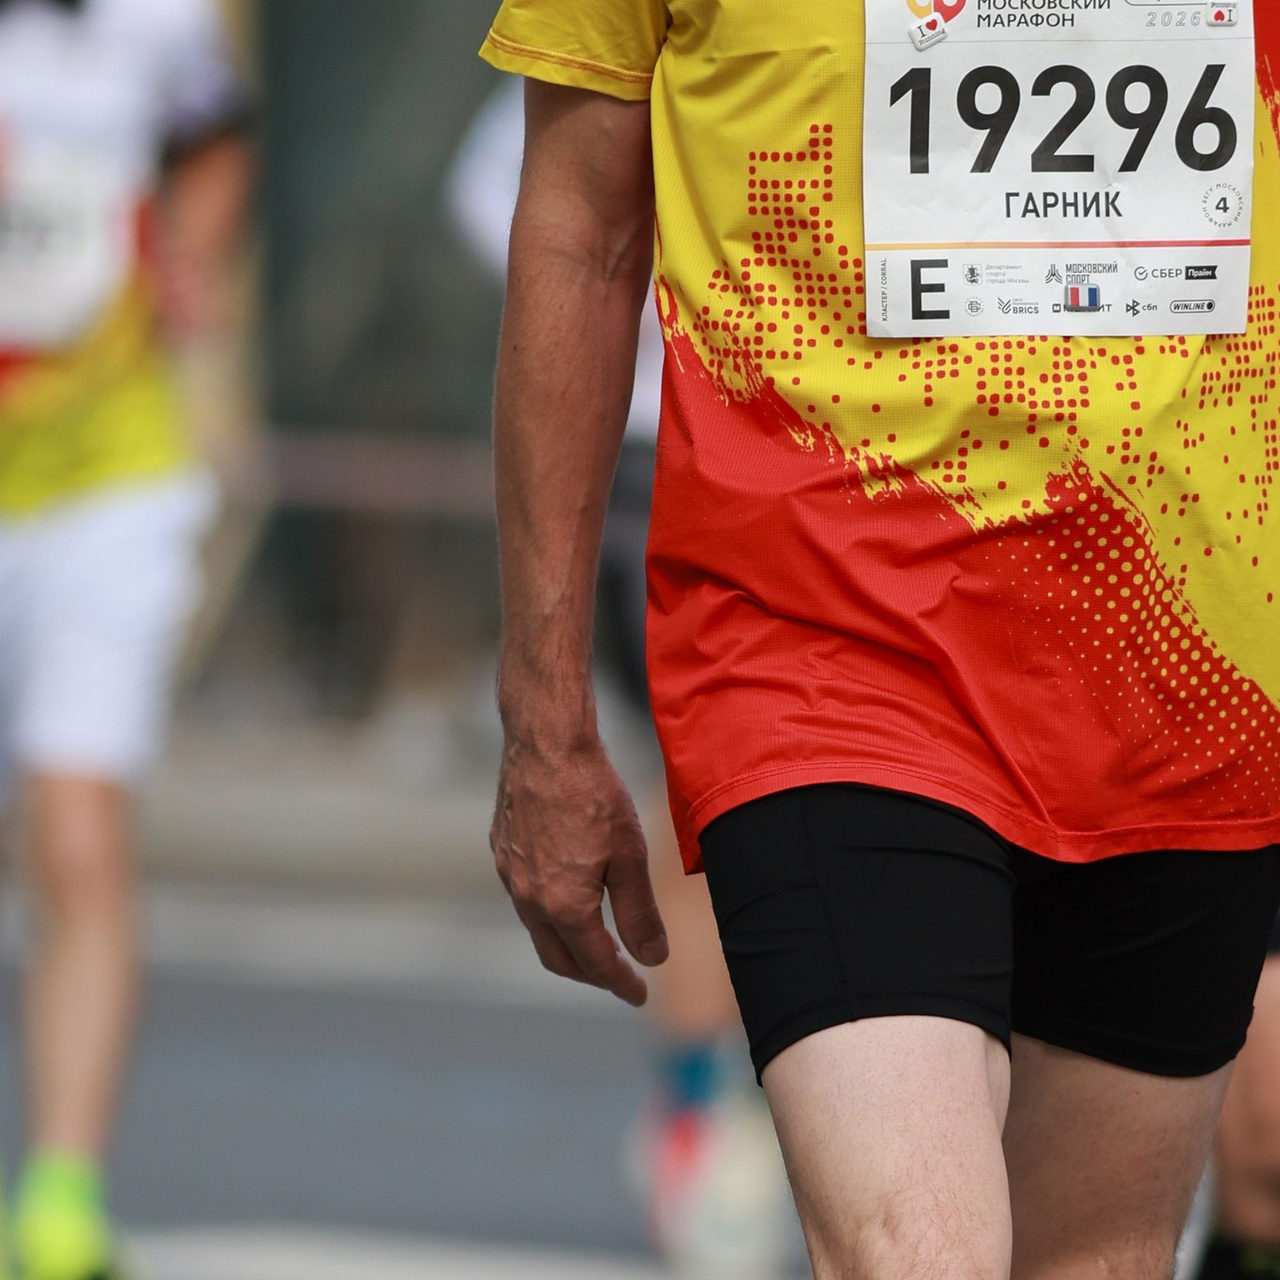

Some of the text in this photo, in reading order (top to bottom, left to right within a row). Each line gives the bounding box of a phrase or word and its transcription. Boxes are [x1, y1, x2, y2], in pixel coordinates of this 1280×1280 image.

[977, 14, 1075, 28] МАРАФОН
[1146, 11, 1201, 27] 2026
[916, 24, 926, 38] I
[889, 64, 1238, 174] 19296
[1004, 191, 1123, 218] ГАРНИК
[1215, 196, 1230, 213] 4
[880, 258, 888, 285] CORRAL
[1065, 260, 1119, 274] МОСКОВСКИЙ
[1151, 268, 1213, 279] СБЕР Прайм
[910, 259, 950, 320] E
[1012, 306, 1040, 315] BRICS
[1173, 302, 1206, 312] WINLINE
